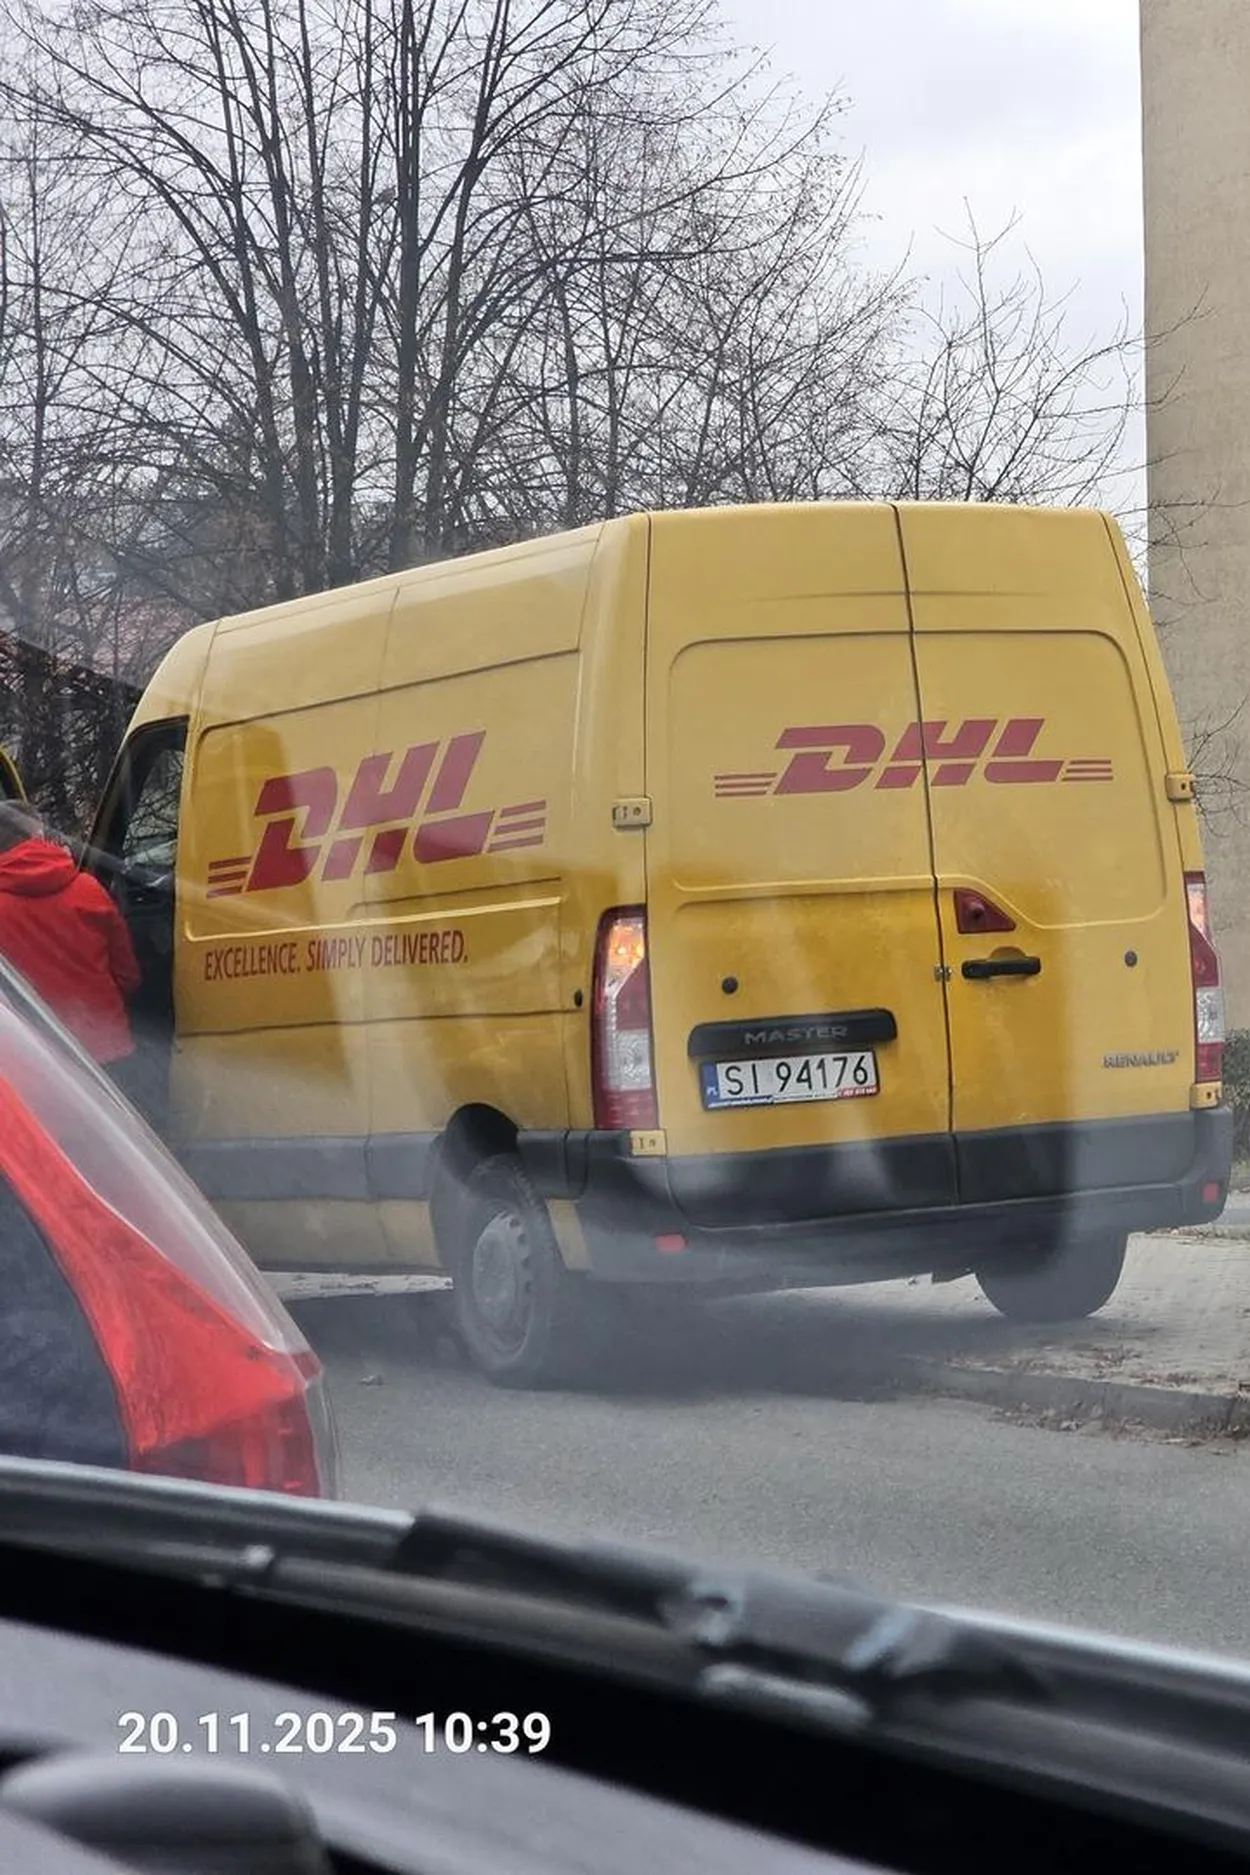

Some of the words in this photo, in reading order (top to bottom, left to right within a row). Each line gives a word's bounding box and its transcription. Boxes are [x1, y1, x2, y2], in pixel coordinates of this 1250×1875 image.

[774, 718, 1066, 795] DHL
[245, 731, 495, 893] DHL
[204, 942, 301, 981] EXCELLENCE.
[306, 937, 367, 972] SIMPLY
[371, 930, 468, 968] DELIVERED.
[744, 1024, 848, 1045] MASTER
[725, 1063, 759, 1096] SI
[775, 1055, 869, 1093] 94176
[1103, 1050, 1179, 1069] RENAULT
